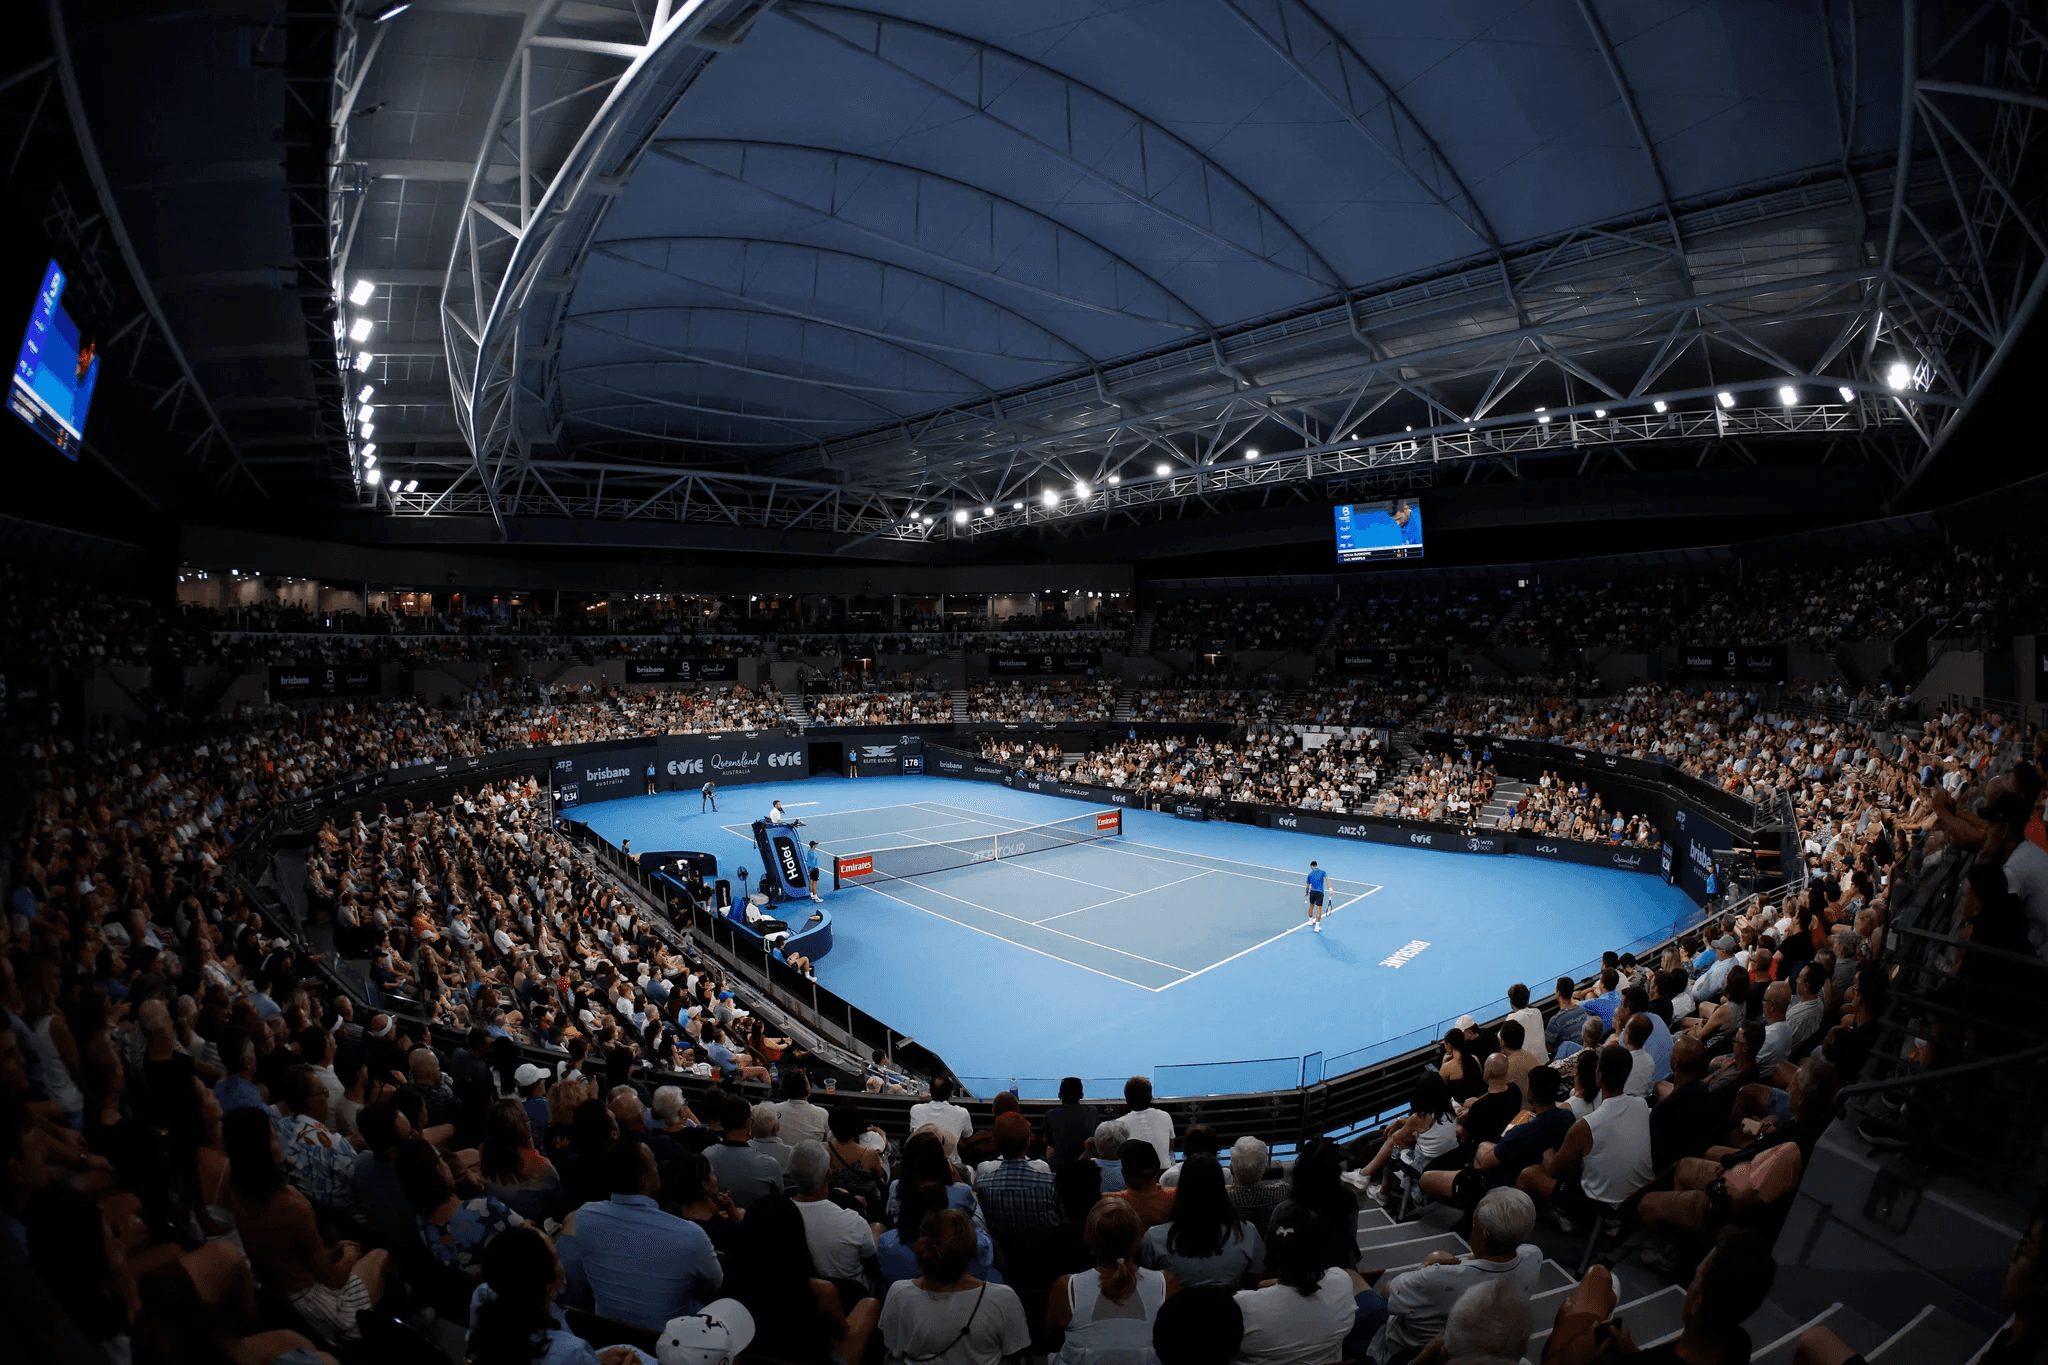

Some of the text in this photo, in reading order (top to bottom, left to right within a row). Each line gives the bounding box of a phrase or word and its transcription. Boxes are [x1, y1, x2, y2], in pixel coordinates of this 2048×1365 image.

[711, 751, 760, 770] Queensland
[905, 759, 918, 767] 178
[586, 767, 630, 782] brisbane
[722, 768, 750, 776] AUSTRALIA
[1097, 817, 1118, 827] Emirates
[1337, 825, 1357, 836] ANZ
[781, 846, 799, 880] Haier
[840, 861, 872, 874] Emirates
